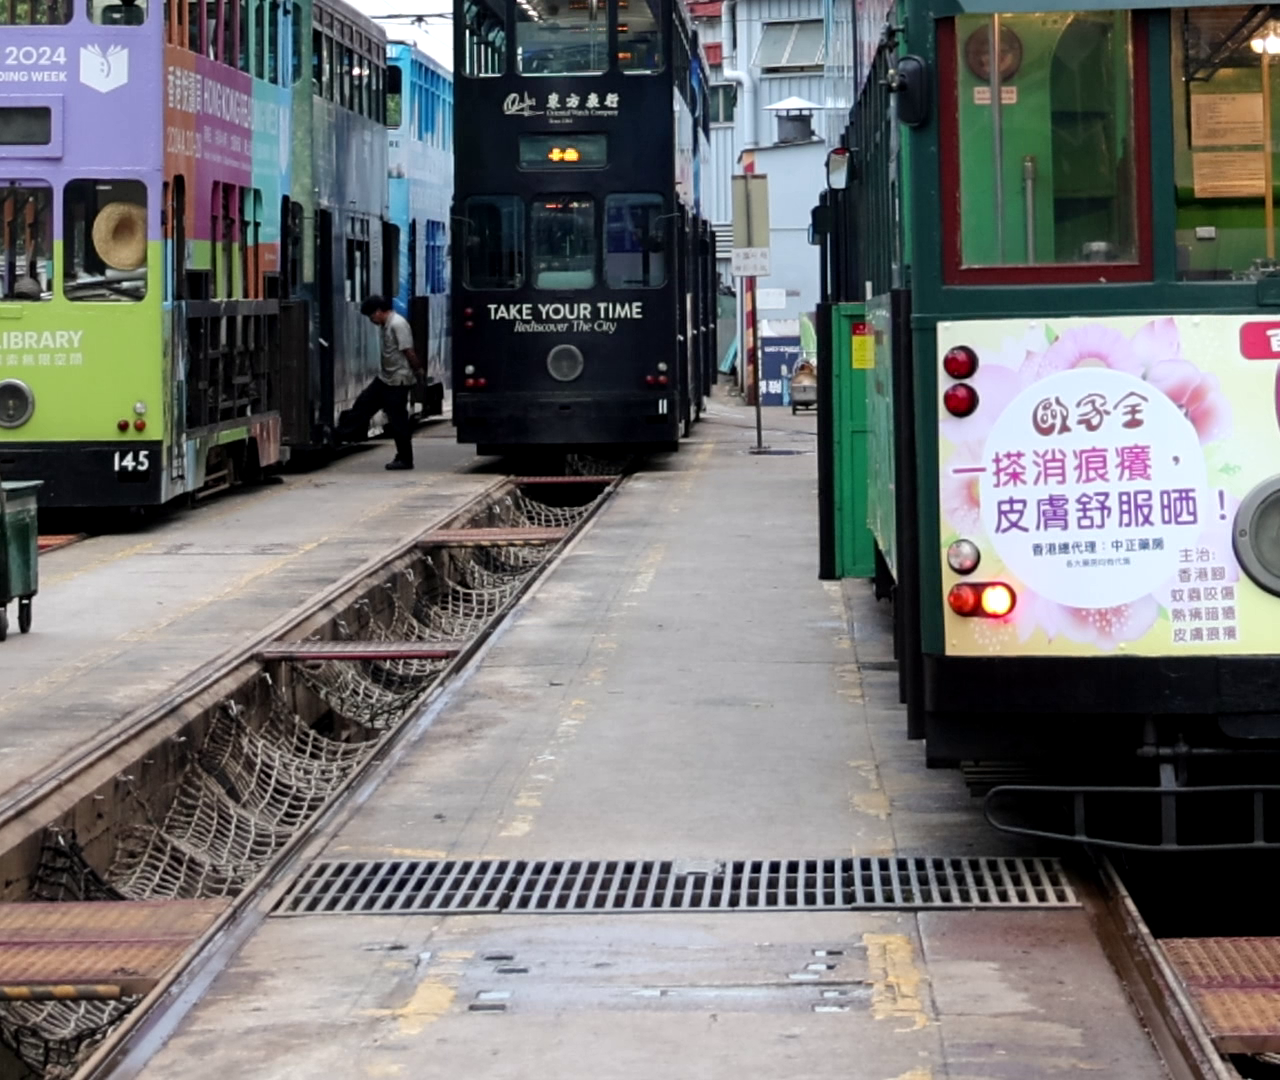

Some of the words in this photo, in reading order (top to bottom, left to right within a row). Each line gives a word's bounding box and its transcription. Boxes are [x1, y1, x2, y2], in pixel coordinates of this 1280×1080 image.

[5, 47, 67, 66] 2024
[31, 71, 67, 82] WEEK
[546, 92, 619, 108] 東方表行
[487, 304, 533, 320] TAKE
[538, 303, 591, 319] YOUR
[597, 302, 643, 318] TIME
[514, 321, 569, 332] Rediscover
[572, 320, 591, 332] The
[594, 321, 617, 334] City
[658, 398, 668, 414] 11
[114, 451, 149, 472] 145
[1178, 567, 1226, 583] 香港腳
[1173, 626, 1237, 643] 皮膚痕癢
